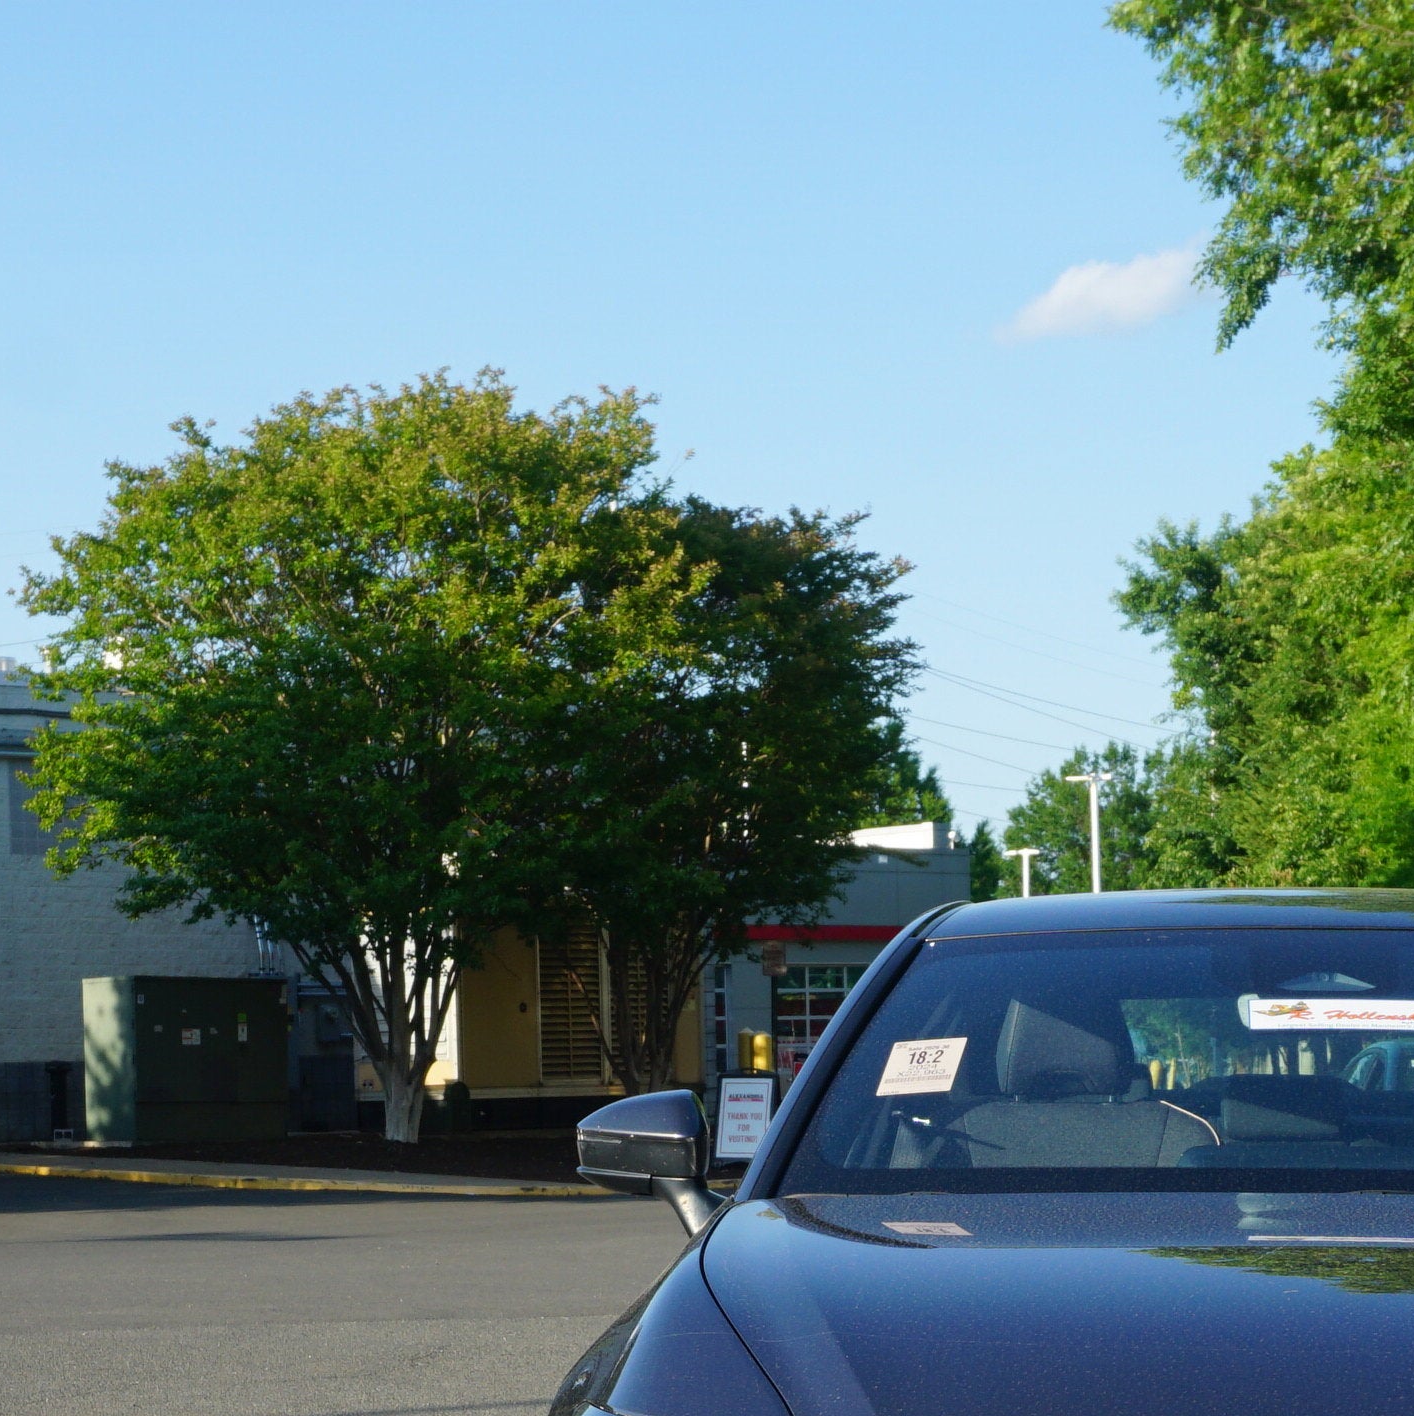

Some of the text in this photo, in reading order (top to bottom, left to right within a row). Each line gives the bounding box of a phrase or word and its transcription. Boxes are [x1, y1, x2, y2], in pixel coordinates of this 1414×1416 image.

[909, 1050, 944, 1065] 18:2
[727, 1112, 763, 1120] THANK YOU
